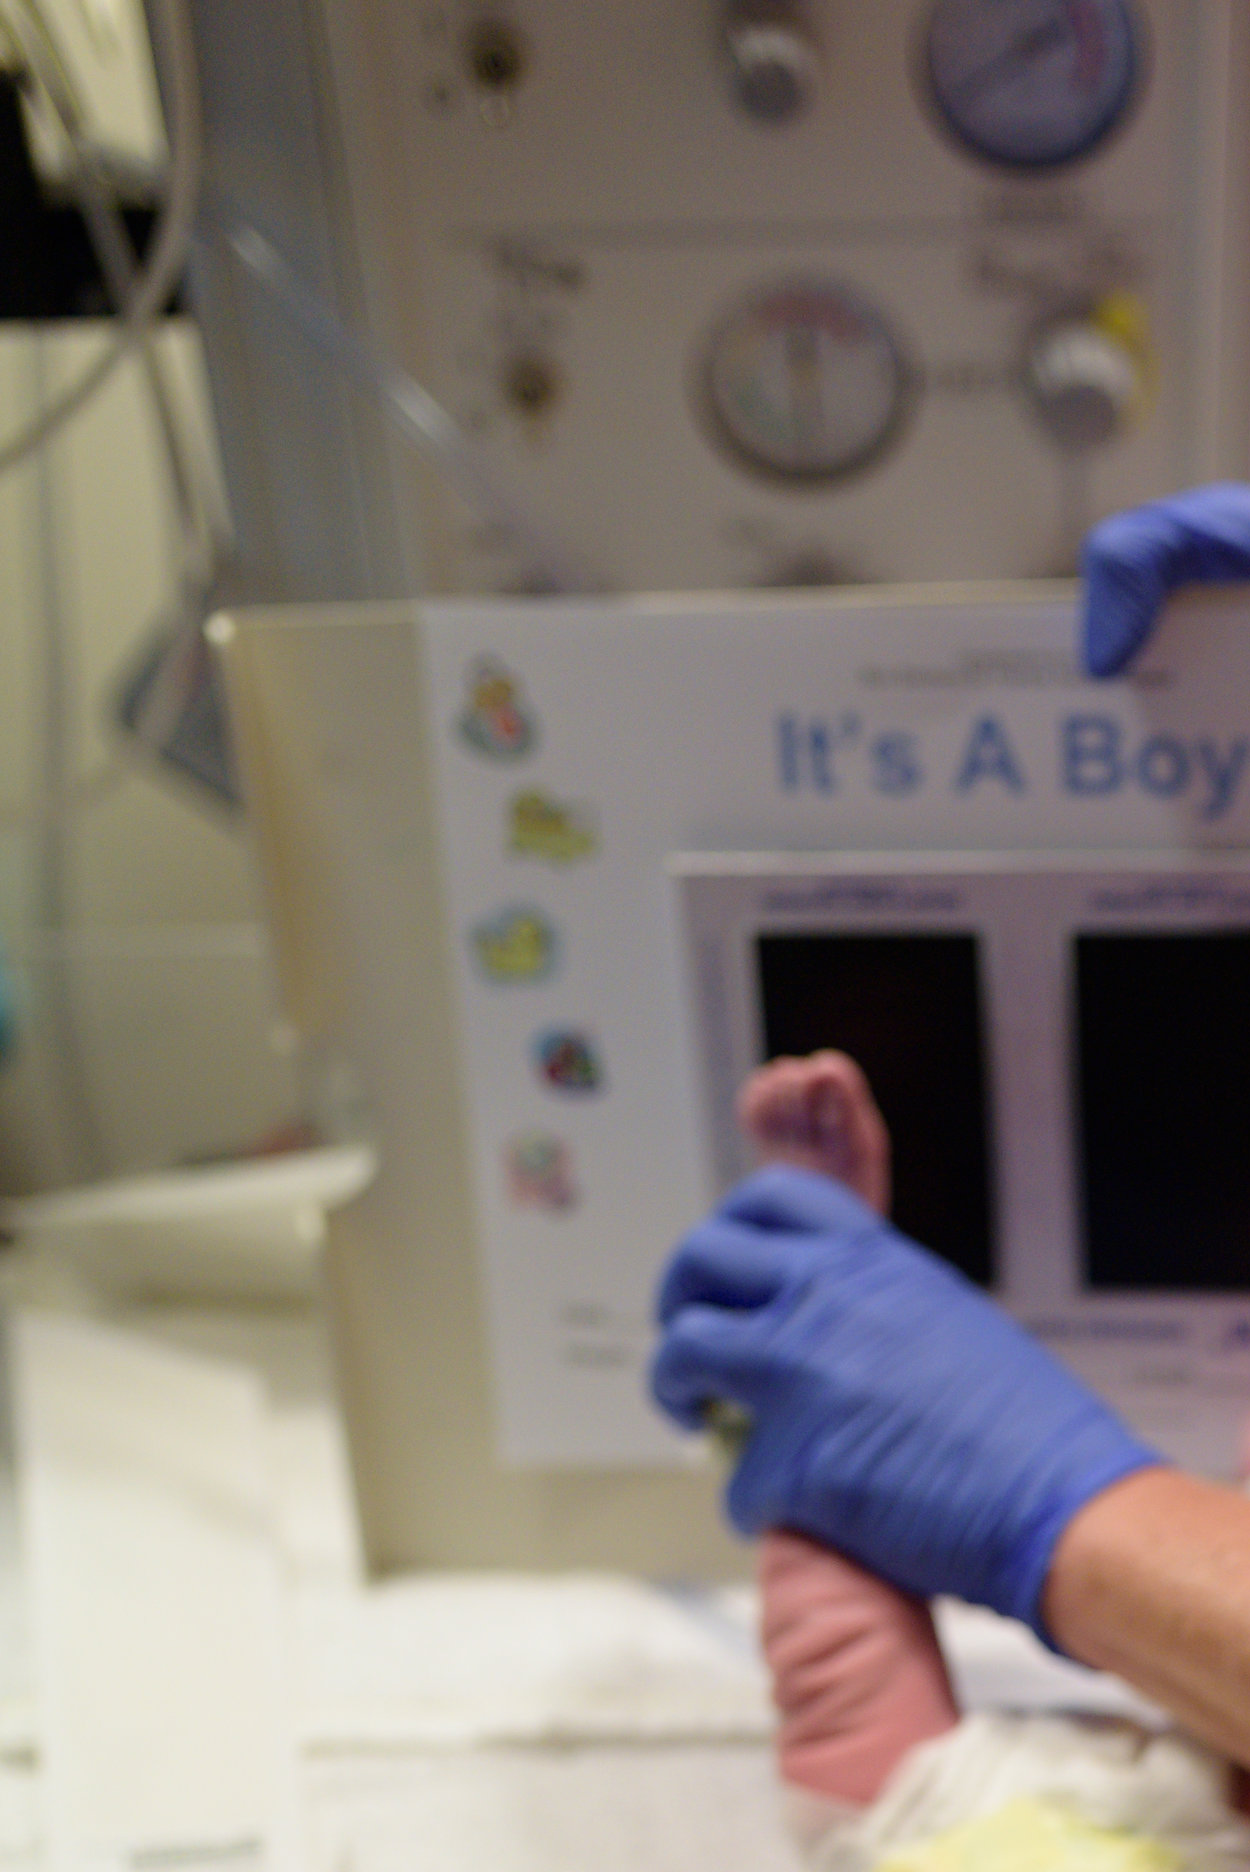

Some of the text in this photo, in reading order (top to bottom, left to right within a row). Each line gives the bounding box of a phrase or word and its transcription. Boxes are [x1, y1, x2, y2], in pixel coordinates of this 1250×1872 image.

[775, 709, 1250, 823] It's A Boy
